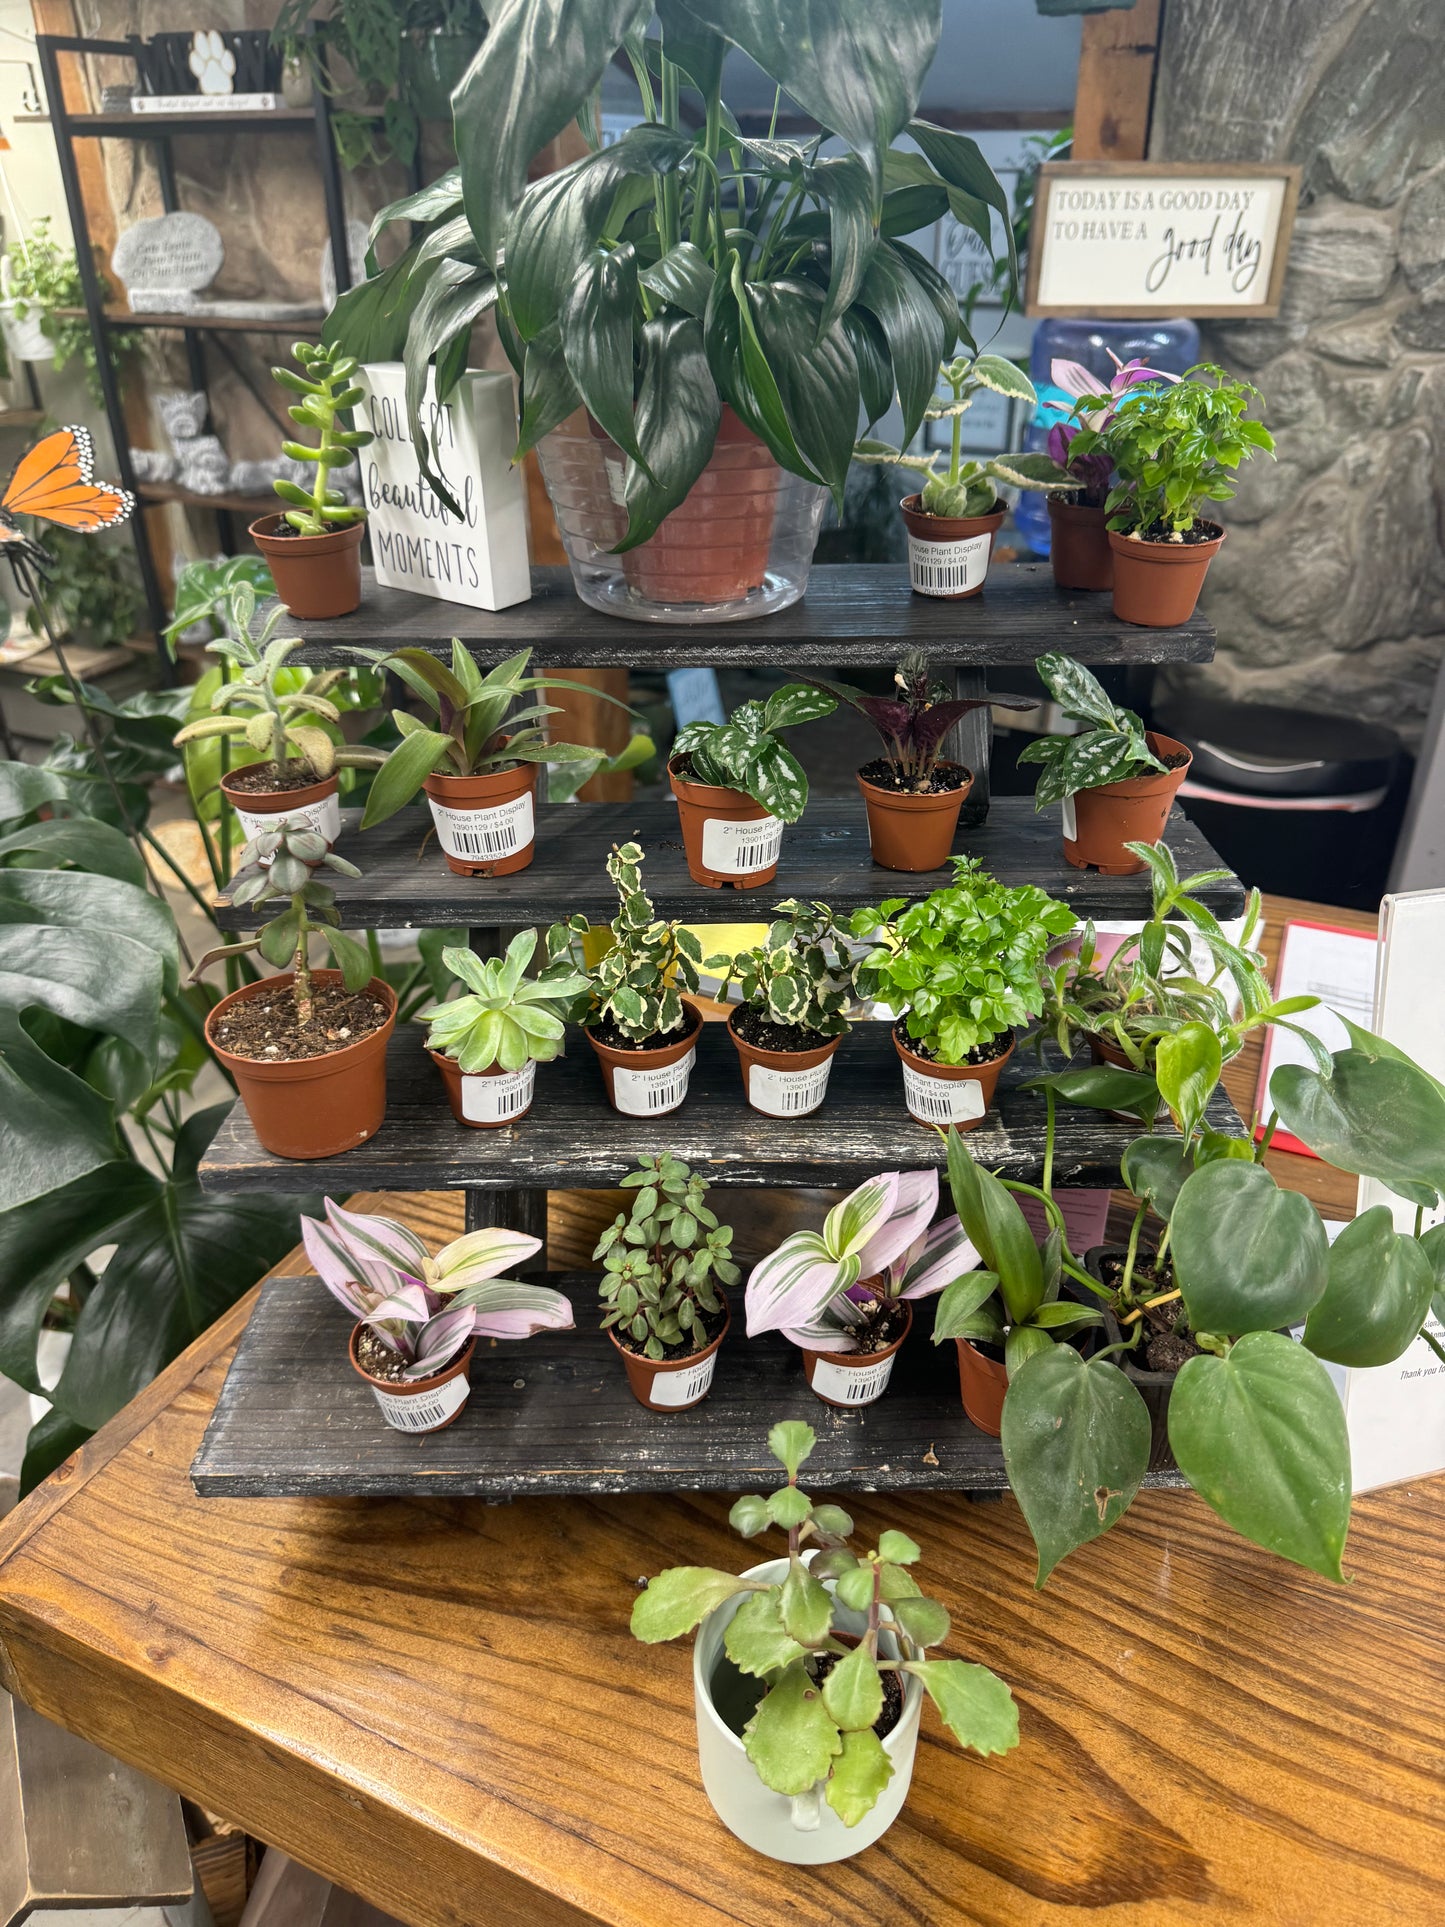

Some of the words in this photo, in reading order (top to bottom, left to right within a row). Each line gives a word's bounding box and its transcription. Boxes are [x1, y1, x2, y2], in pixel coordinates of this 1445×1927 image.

[1056, 191, 1121, 210] TODAY
[1124, 191, 1140, 210] IS
[1141, 191, 1154, 210] A
[1159, 191, 1211, 210] GOOD
[1216, 191, 1255, 210] DAY
[1053, 222, 1079, 240] TO
[1082, 222, 1133, 240] HAVE
[1135, 222, 1148, 240] A
[1146, 214, 1221, 293] good
[1223, 211, 1261, 293] day
[370, 394, 454, 448] COLCT
[931, 547, 952, 556] Plant
[954, 541, 983, 555] Display
[378, 530, 479, 588] MOMENTS
[445, 811, 472, 823] House
[474, 812, 498, 822] Plant
[499, 801, 527, 818] Display
[453, 822, 488, 831] 13901129
[494, 817, 515, 829] $4.00
[723, 826, 733, 835] 2"
[735, 825, 763, 835] House
[631, 1074, 641, 1082] 2"
[643, 1071, 671, 1082] House
[779, 1075, 808, 1083] House
[481, 1080, 491, 1088] 2"
[933, 1080, 967, 1090] Display
[928, 1089, 950, 1098] $4.00
[848, 1368, 878, 1377] House
[1400, 1368, 1422, 1380] Thank
[1422, 1368, 1437, 1378] you
[420, 1381, 452, 1401] Display
